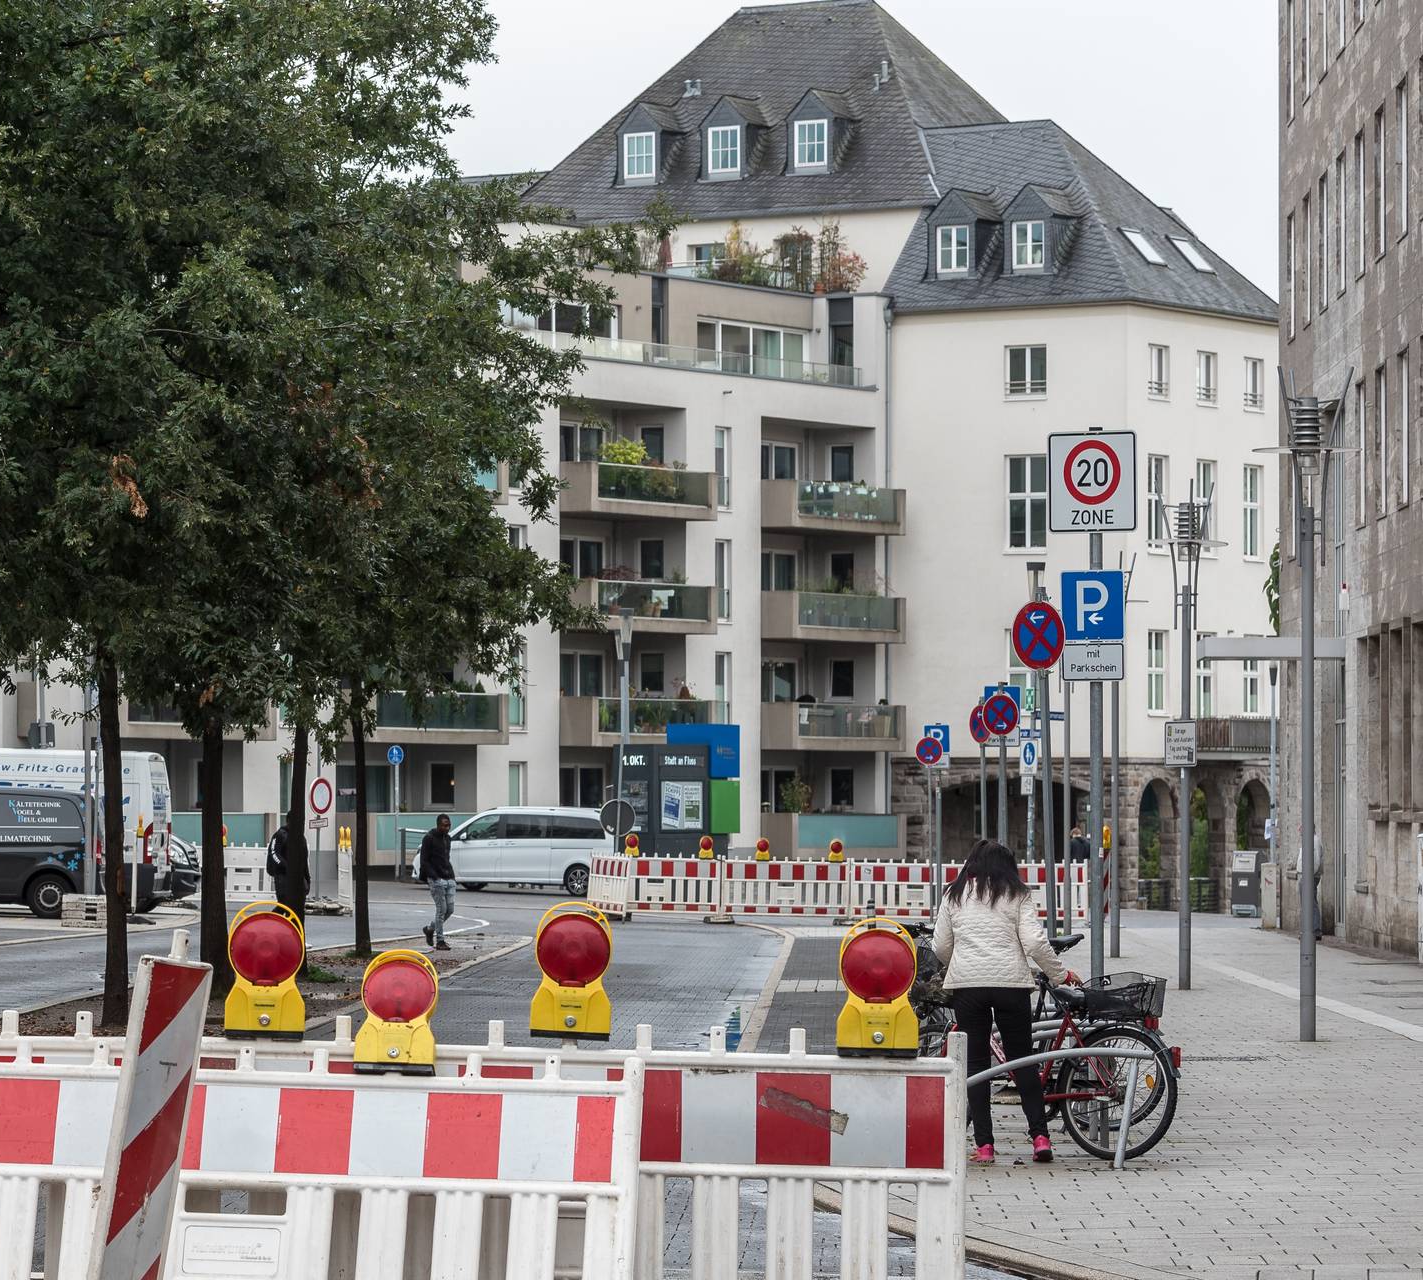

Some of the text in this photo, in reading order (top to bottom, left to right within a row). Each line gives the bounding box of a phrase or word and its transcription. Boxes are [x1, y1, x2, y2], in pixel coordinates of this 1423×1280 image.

[1077, 457, 1109, 487] 20
[1071, 509, 1114, 525] ZONE
[1087, 649, 1101, 659] mit
[1070, 663, 1117, 673] Parkschein
[12, 807, 34, 816] VOGEL
